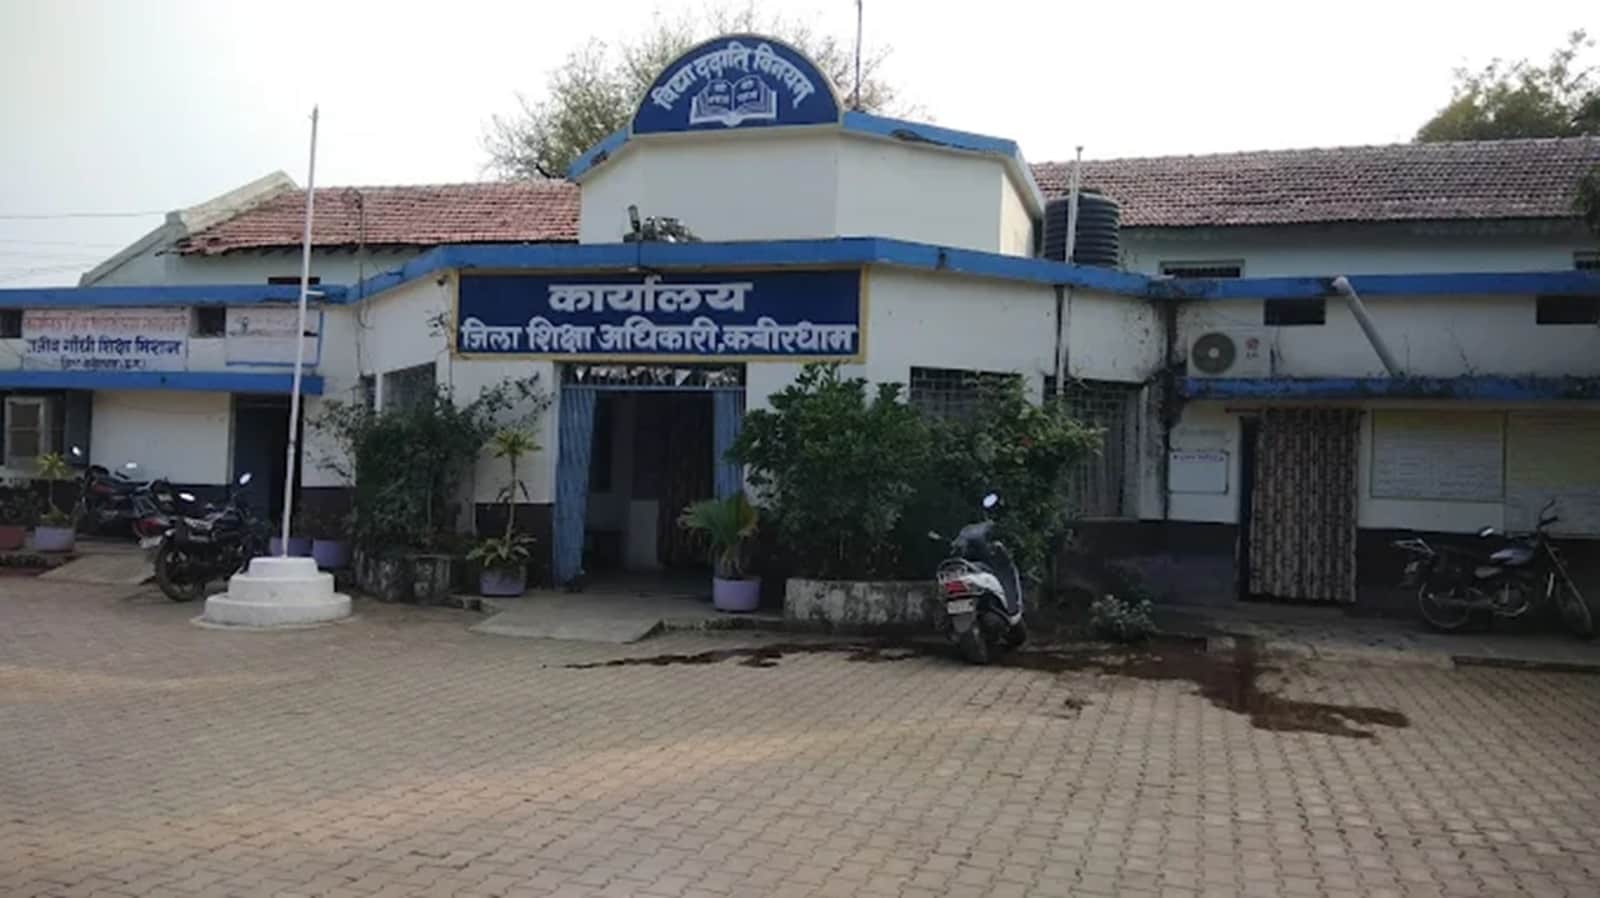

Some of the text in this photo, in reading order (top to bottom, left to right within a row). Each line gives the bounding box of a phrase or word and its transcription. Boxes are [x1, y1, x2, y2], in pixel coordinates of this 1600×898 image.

[651, 64, 697, 110] विद्या
[548, 275, 753, 312] कार्यालय
[461, 317, 523, 350] जिला
[526, 316, 595, 353] शिक्षा
